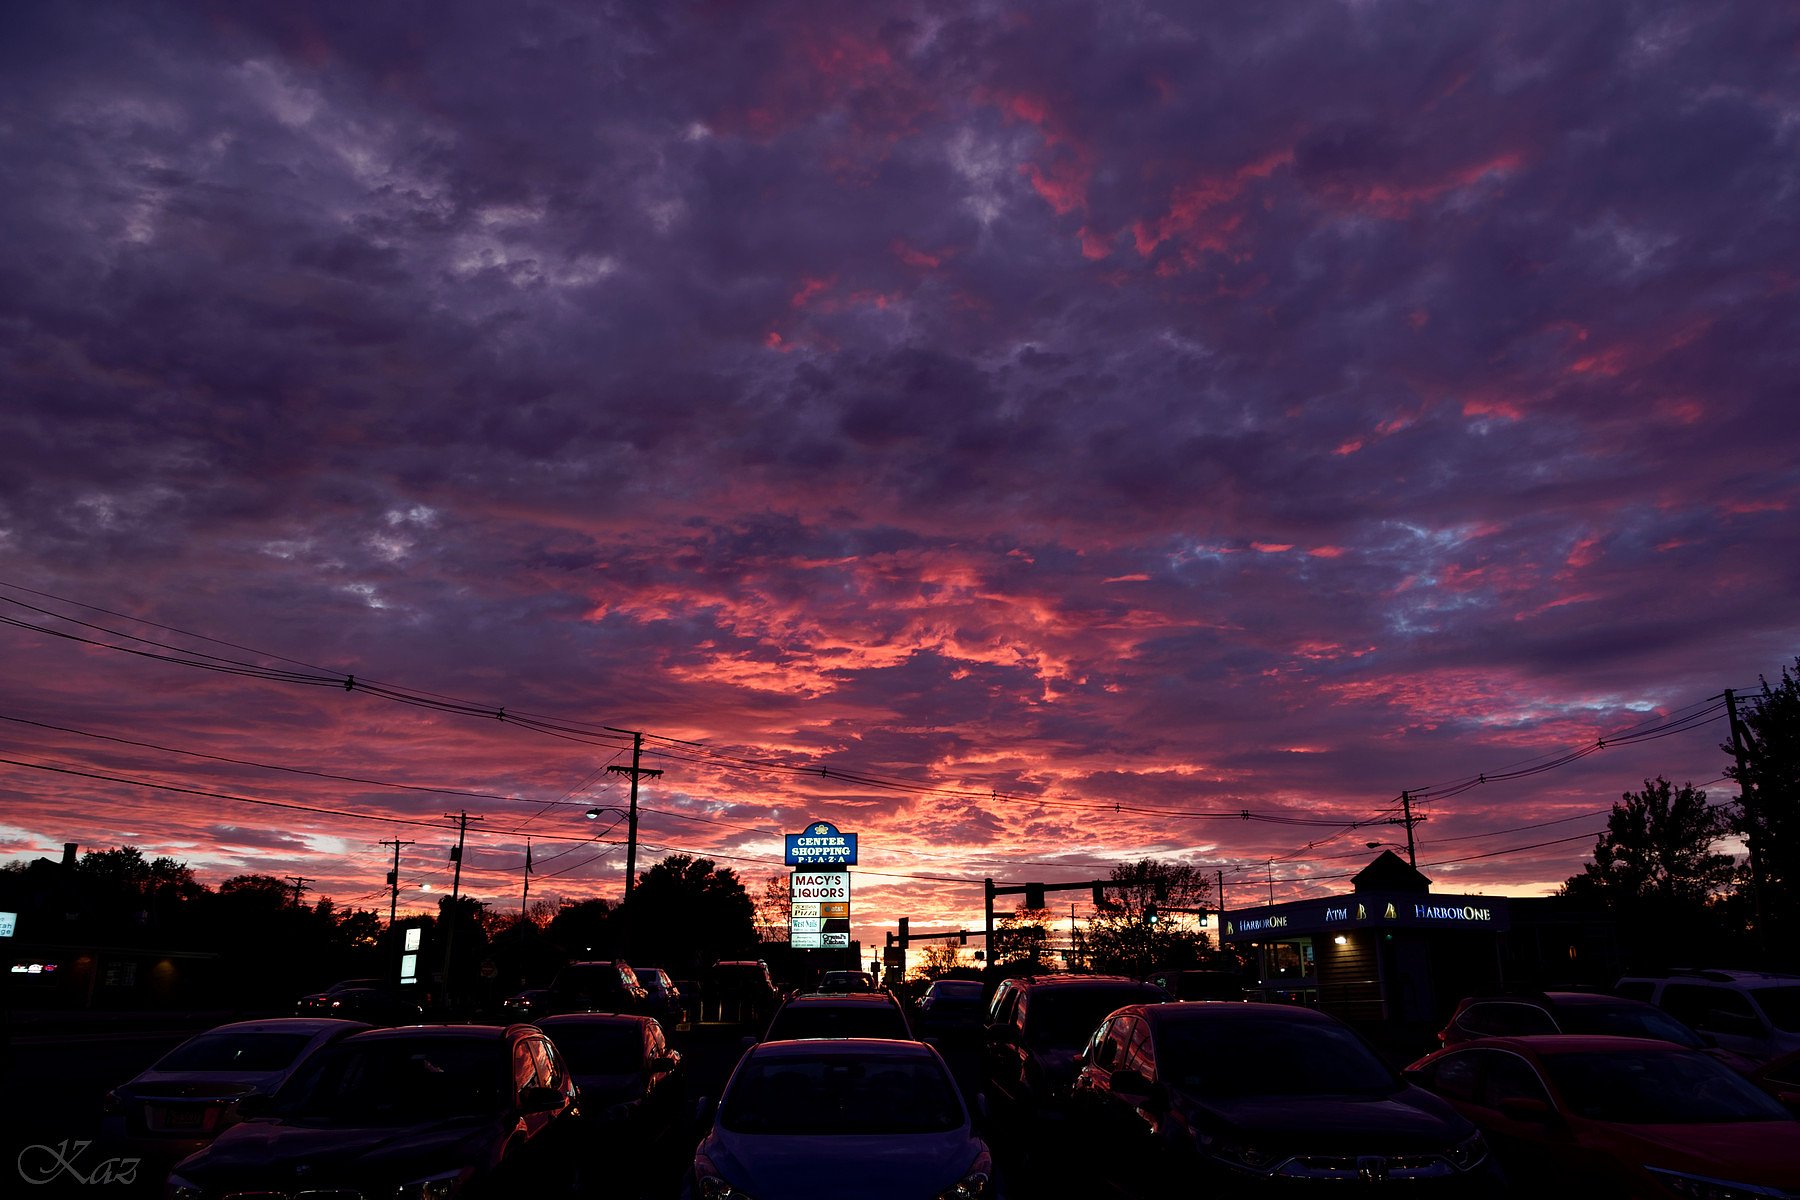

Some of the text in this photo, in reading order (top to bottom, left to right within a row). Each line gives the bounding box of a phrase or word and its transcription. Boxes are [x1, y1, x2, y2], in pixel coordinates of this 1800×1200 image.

[797, 837, 845, 846] CENTER
[791, 846, 851, 856] SHOPPING
[795, 875, 842, 886] MACY'S
[791, 887, 845, 898] LIQUORS
